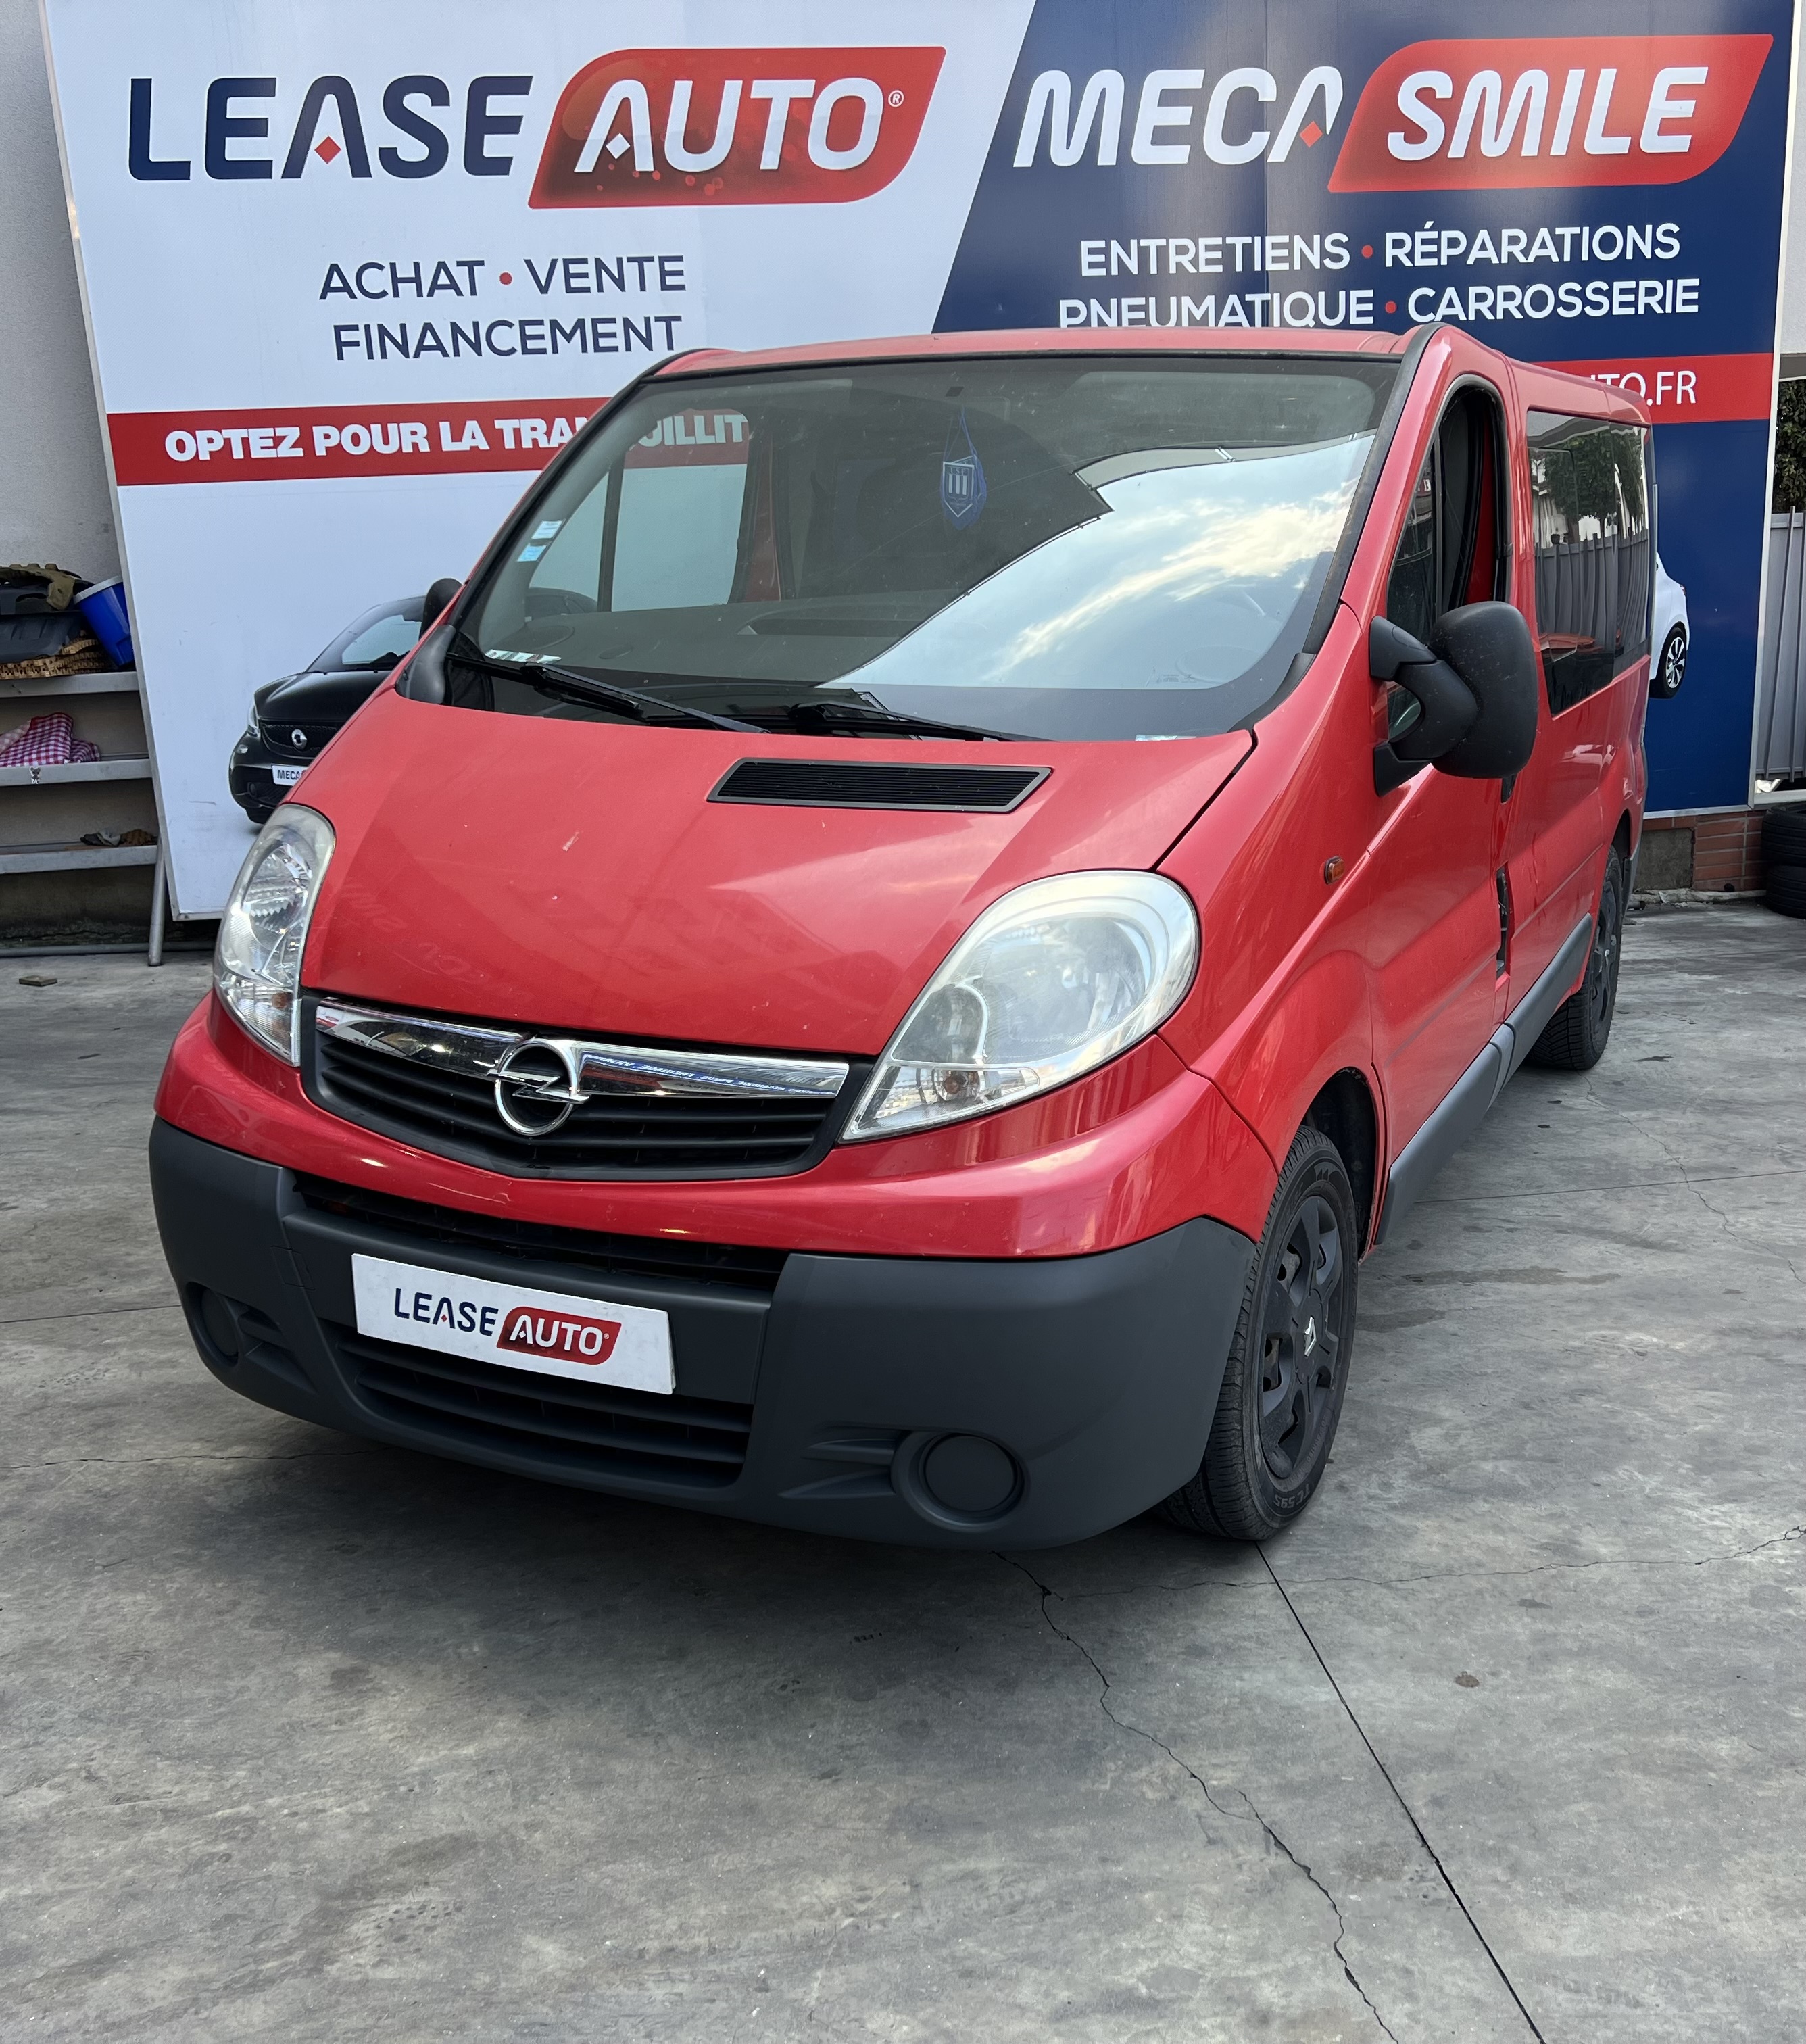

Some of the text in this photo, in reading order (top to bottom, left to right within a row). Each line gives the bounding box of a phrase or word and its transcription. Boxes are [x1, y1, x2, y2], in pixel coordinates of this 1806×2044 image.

[128, 75, 533, 180] LEASE
[1013, 66, 1709, 168] MECA SMILE
[1080, 221, 1681, 277] ENTRETIENS RÉPARATIONS
[319, 255, 687, 301] ACHAT VENTE
[1060, 278, 1700, 328] PNEUMATIQUE CARROSSERIE
[333, 315, 683, 361] FINANCEMENT
[165, 427, 304, 462] OPTEZ
[314, 421, 429, 457] POUR
[439, 420, 490, 452] LA
[394, 1288, 499, 1336] LEASE
